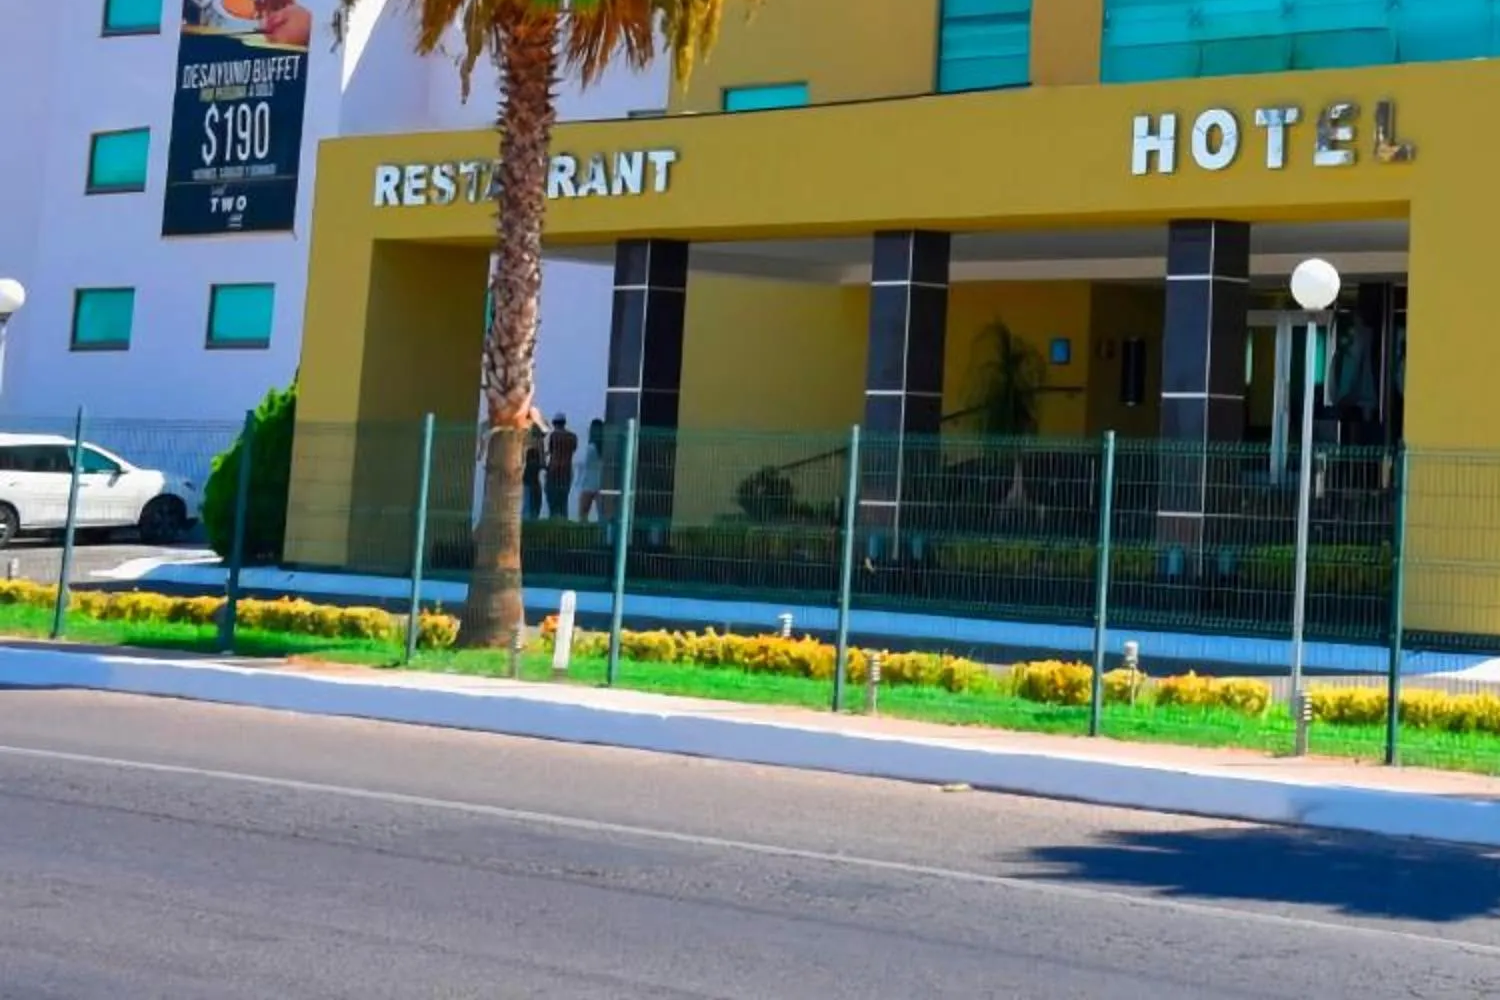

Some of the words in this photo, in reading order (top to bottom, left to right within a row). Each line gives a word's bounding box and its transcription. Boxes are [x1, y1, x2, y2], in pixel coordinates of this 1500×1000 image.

[182, 60, 251, 89] DESAYUNO
[252, 55, 301, 83] BUFFET
[201, 101, 270, 166] $190
[1131, 99, 1416, 175] HOTEL
[210, 195, 247, 213] TWO
[373, 149, 677, 207] RESTARANT
